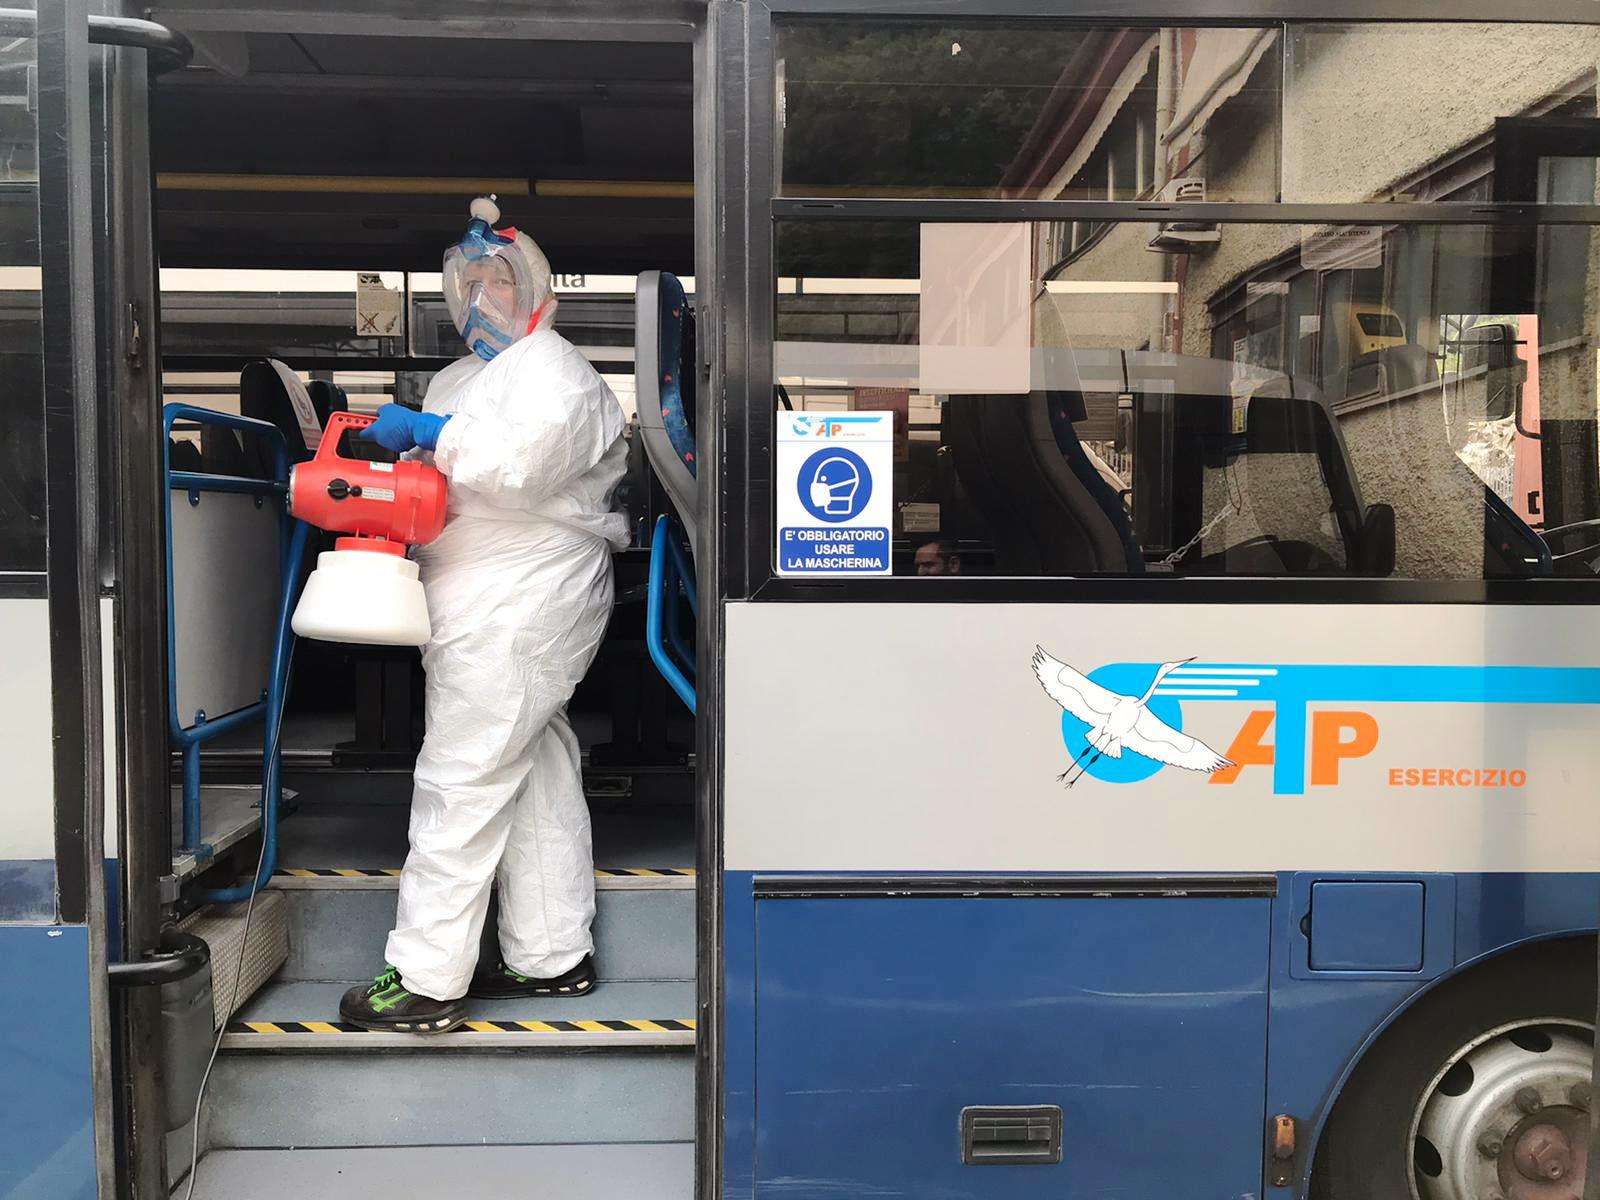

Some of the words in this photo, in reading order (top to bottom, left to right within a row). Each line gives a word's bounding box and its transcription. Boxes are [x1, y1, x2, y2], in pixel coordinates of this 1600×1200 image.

[785, 530, 796, 541] E'
[797, 530, 885, 541] OBBLIGATORIO
[814, 544, 855, 555] USARE
[787, 558, 803, 568] LA
[805, 557, 882, 568] MASCHERINA
[1207, 667, 1379, 794] ATP
[1388, 768, 1527, 787] ESERCIZIO
